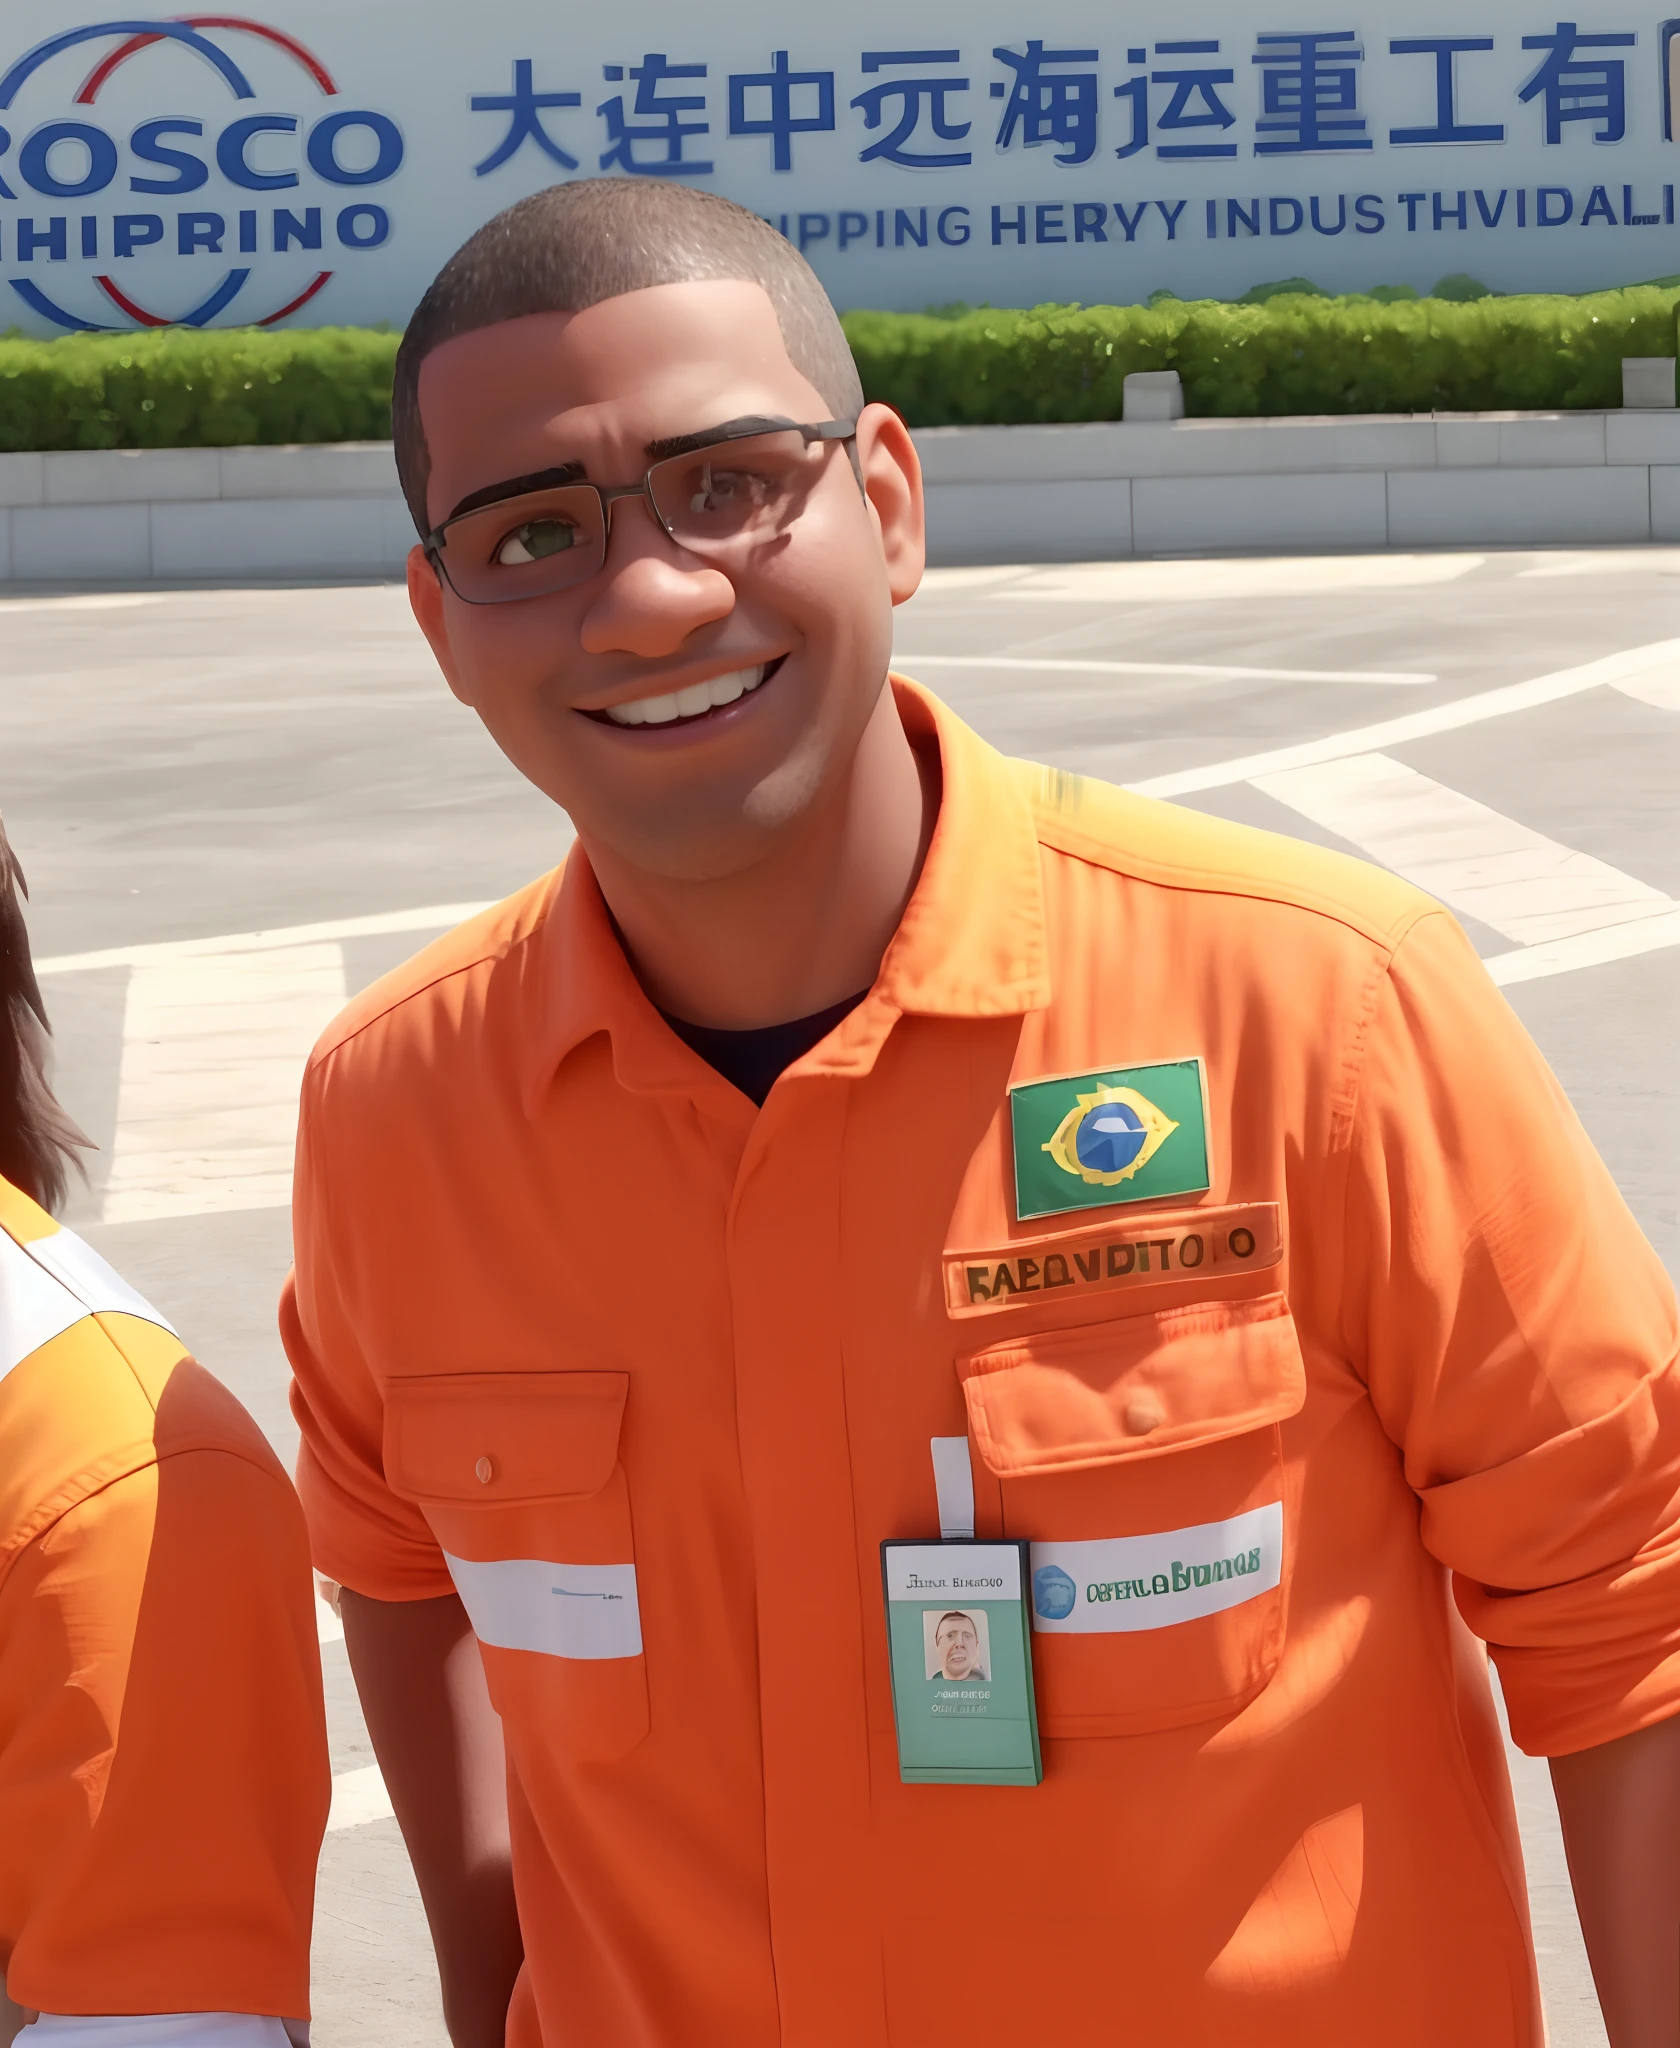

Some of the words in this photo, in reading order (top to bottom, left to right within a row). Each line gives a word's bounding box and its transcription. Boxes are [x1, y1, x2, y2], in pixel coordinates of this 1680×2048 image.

[471, 19, 1680, 176] 大连中远海运重工有
[0, 111, 403, 199] OSCO
[766, 206, 971, 253] IPPING
